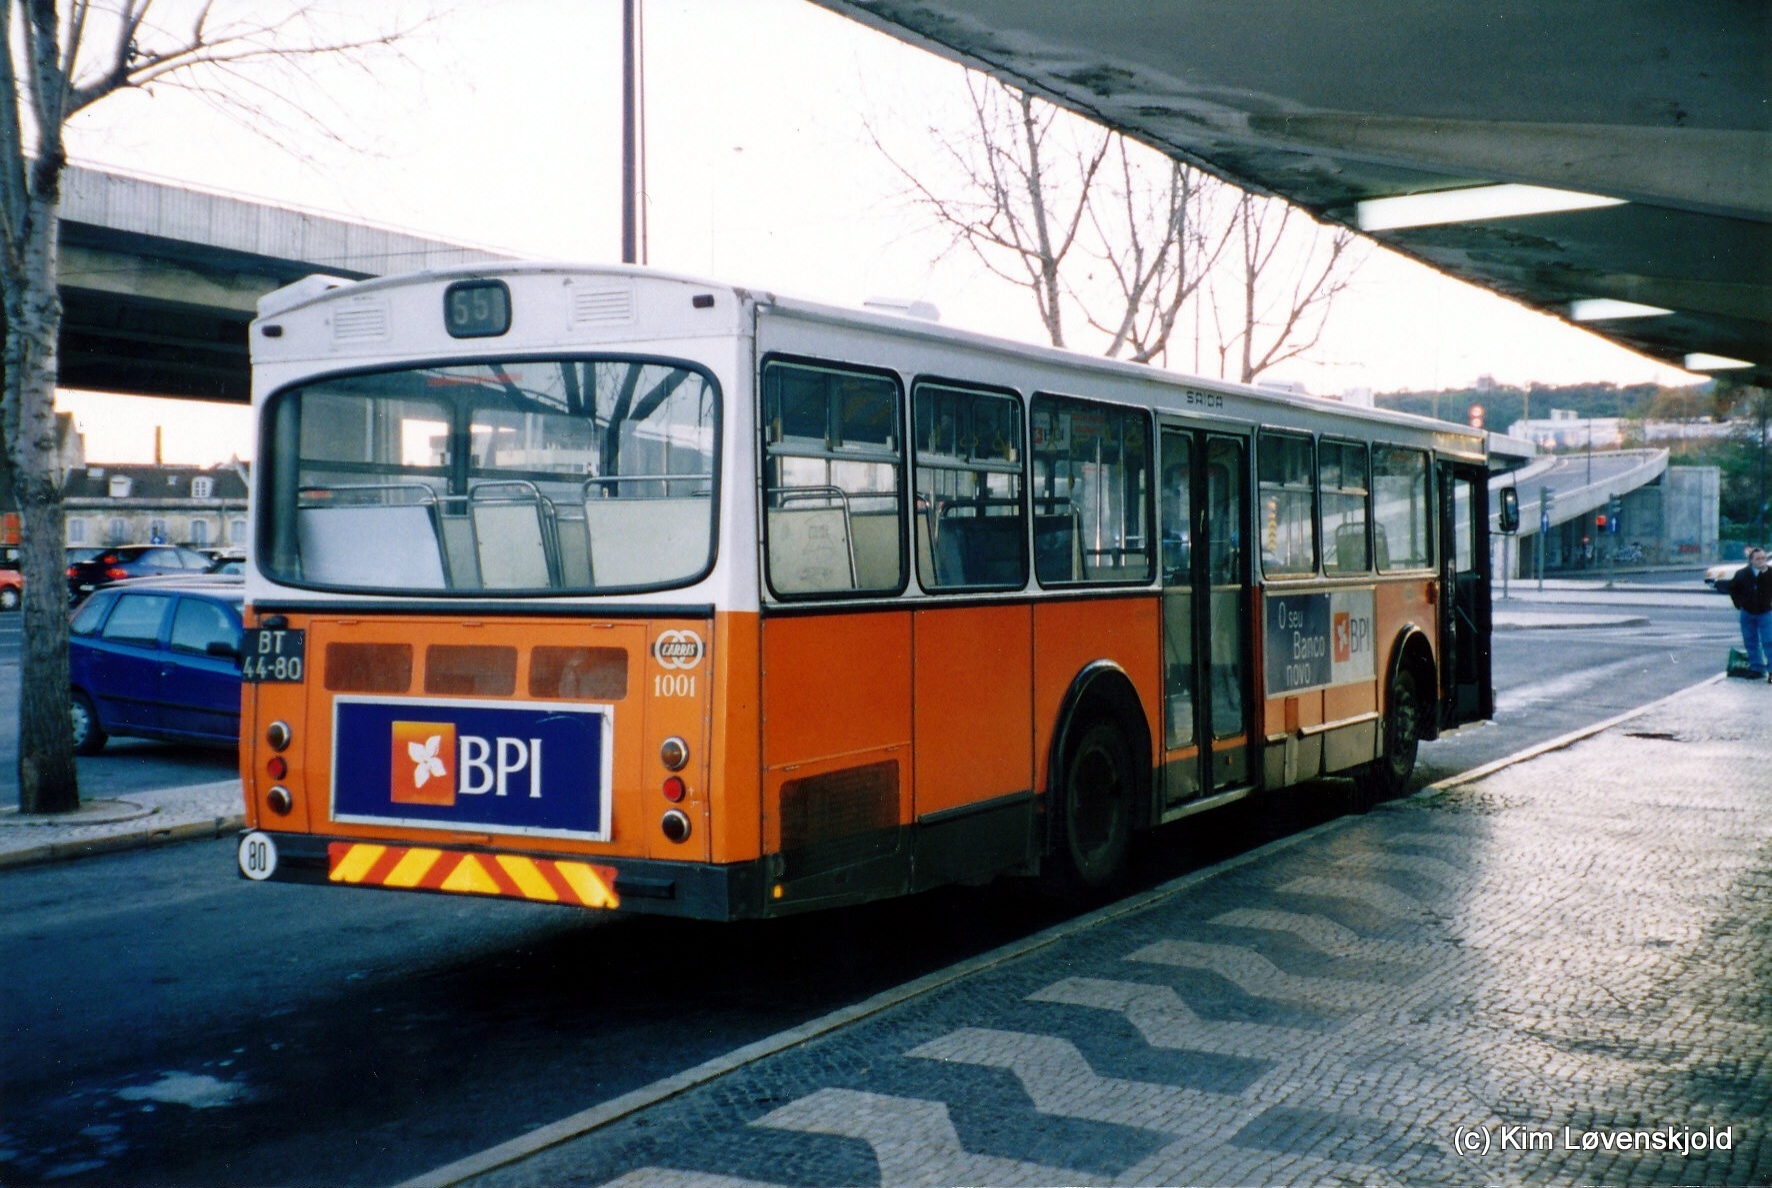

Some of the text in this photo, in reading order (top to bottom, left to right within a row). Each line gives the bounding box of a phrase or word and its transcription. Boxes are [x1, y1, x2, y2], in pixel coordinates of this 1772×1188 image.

[1278, 601, 1304, 629] O seu
[258, 630, 287, 654] BT
[1293, 631, 1326, 660] Banco
[1350, 617, 1370, 653] BPI
[661, 643, 696, 656] CARRIS
[242, 656, 302, 680] 44-80
[1286, 663, 1311, 686] novo
[654, 673, 696, 697] 1001
[458, 735, 542, 798] BPI
[249, 841, 266, 871] 80
